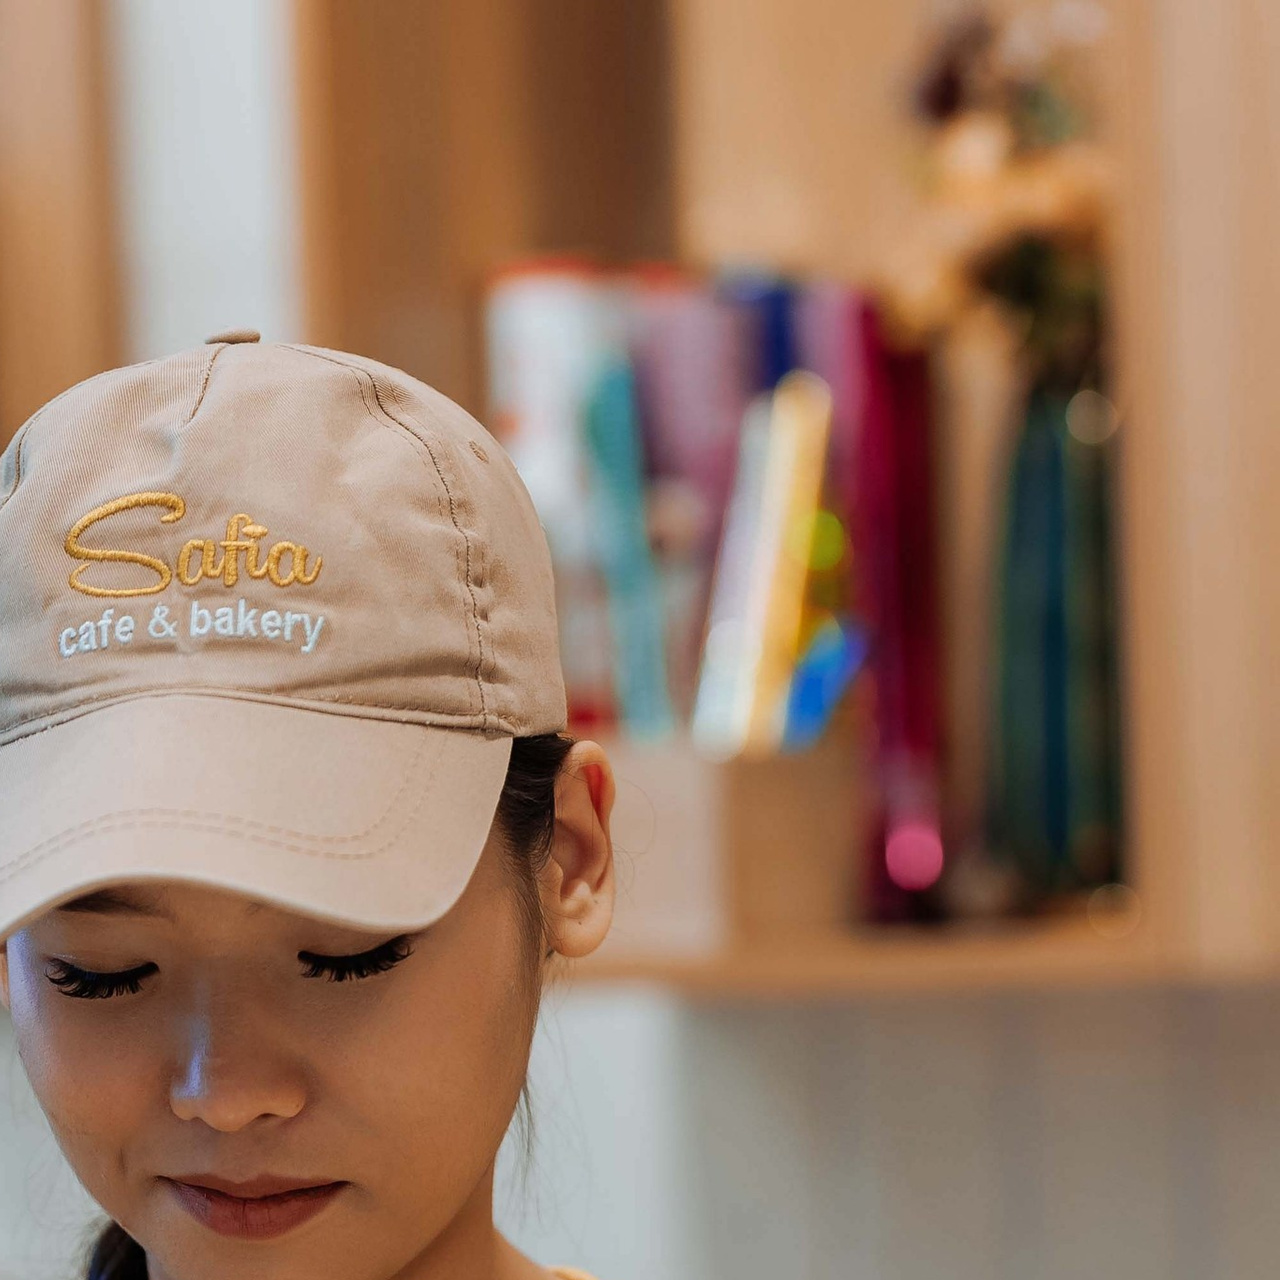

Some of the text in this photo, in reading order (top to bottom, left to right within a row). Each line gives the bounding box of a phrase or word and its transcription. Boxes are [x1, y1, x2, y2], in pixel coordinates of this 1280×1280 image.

[64, 491, 323, 598] Safia
[58, 598, 324, 659] cafe & bakery
